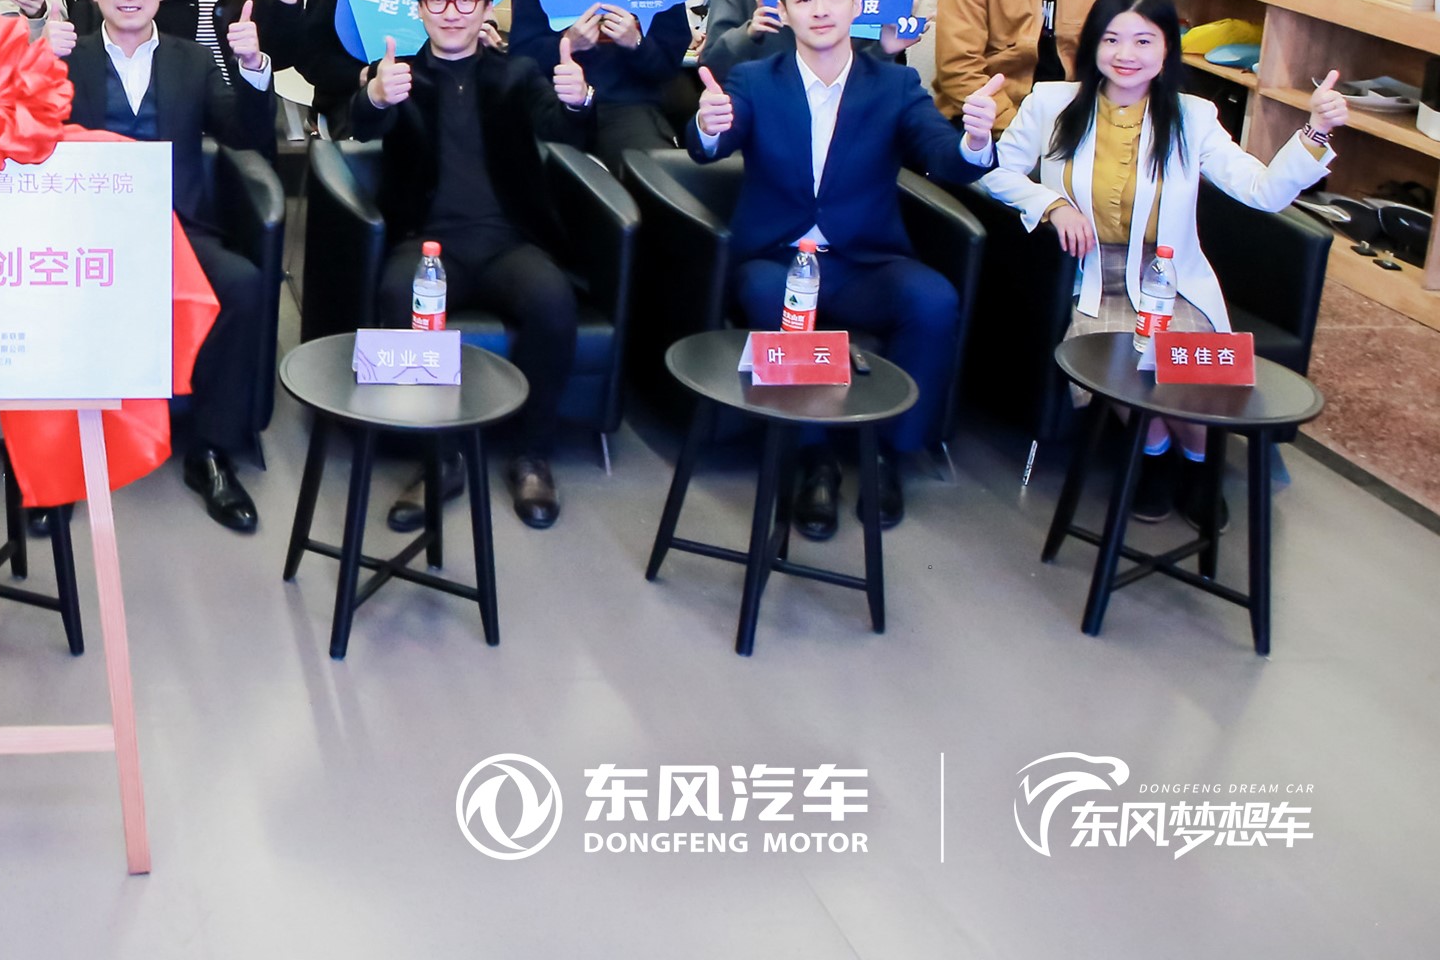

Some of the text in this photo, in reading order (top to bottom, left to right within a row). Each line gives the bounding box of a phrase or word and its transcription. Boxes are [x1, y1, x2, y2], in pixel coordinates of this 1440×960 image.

[376, 349, 441, 368] 刘业宝
[1170, 347, 1235, 366] 骆佳杏
